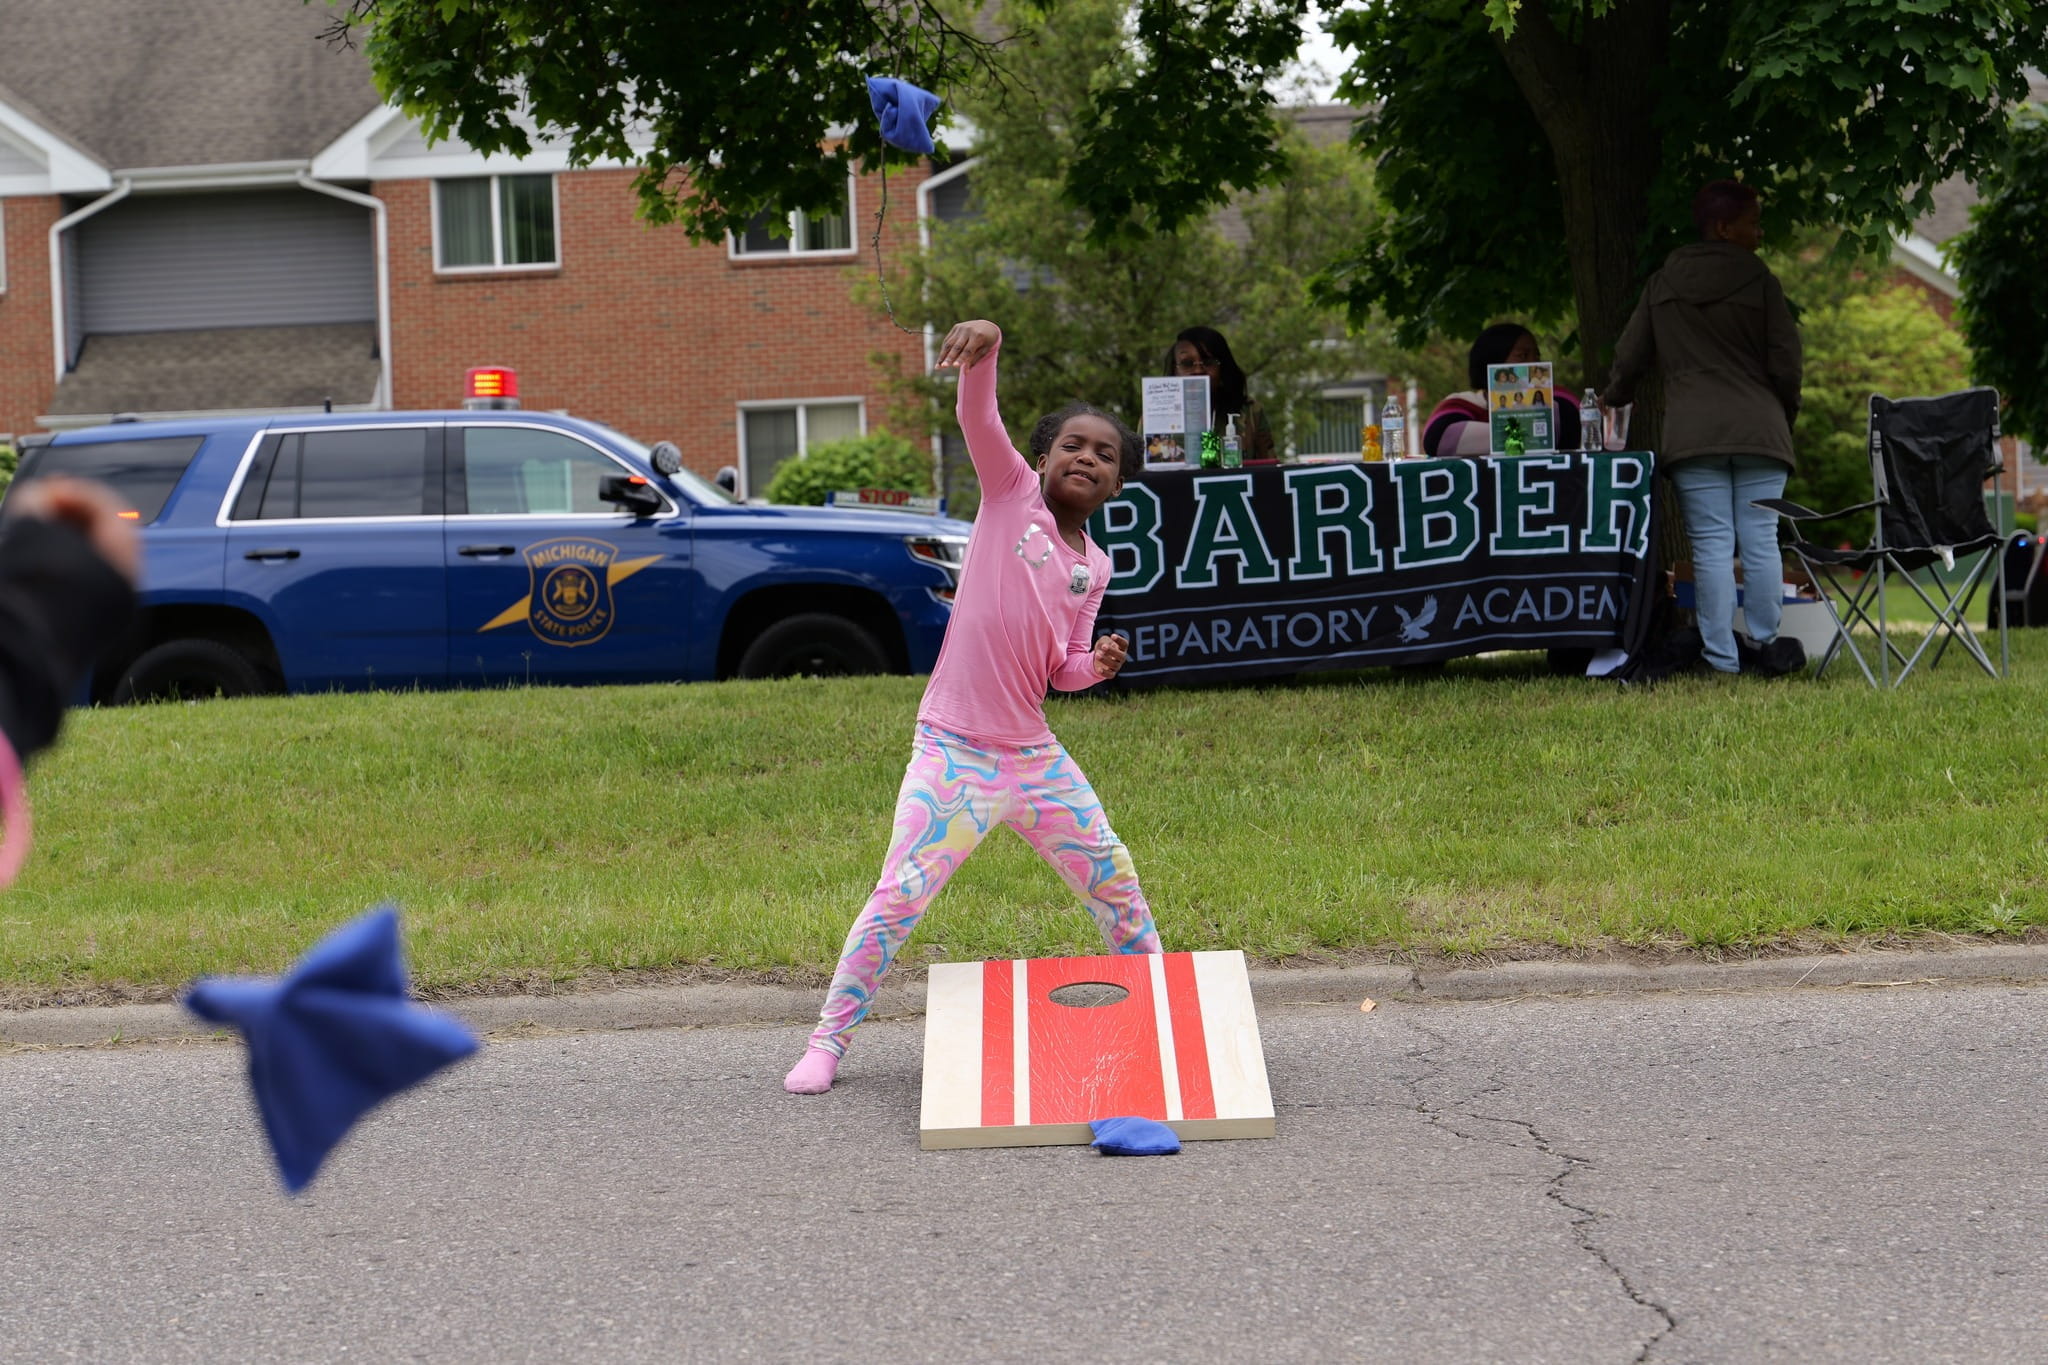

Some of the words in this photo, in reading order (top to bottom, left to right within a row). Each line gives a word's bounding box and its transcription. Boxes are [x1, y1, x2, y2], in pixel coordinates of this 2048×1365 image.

[859, 488, 910, 506] STOP
[1085, 451, 1654, 595] BARBER
[533, 545, 609, 567] MICHIGAN
[535, 610, 566, 635] STATE
[570, 609, 607, 635] POLICE
[1097, 605, 1378, 662] EPARATORY
